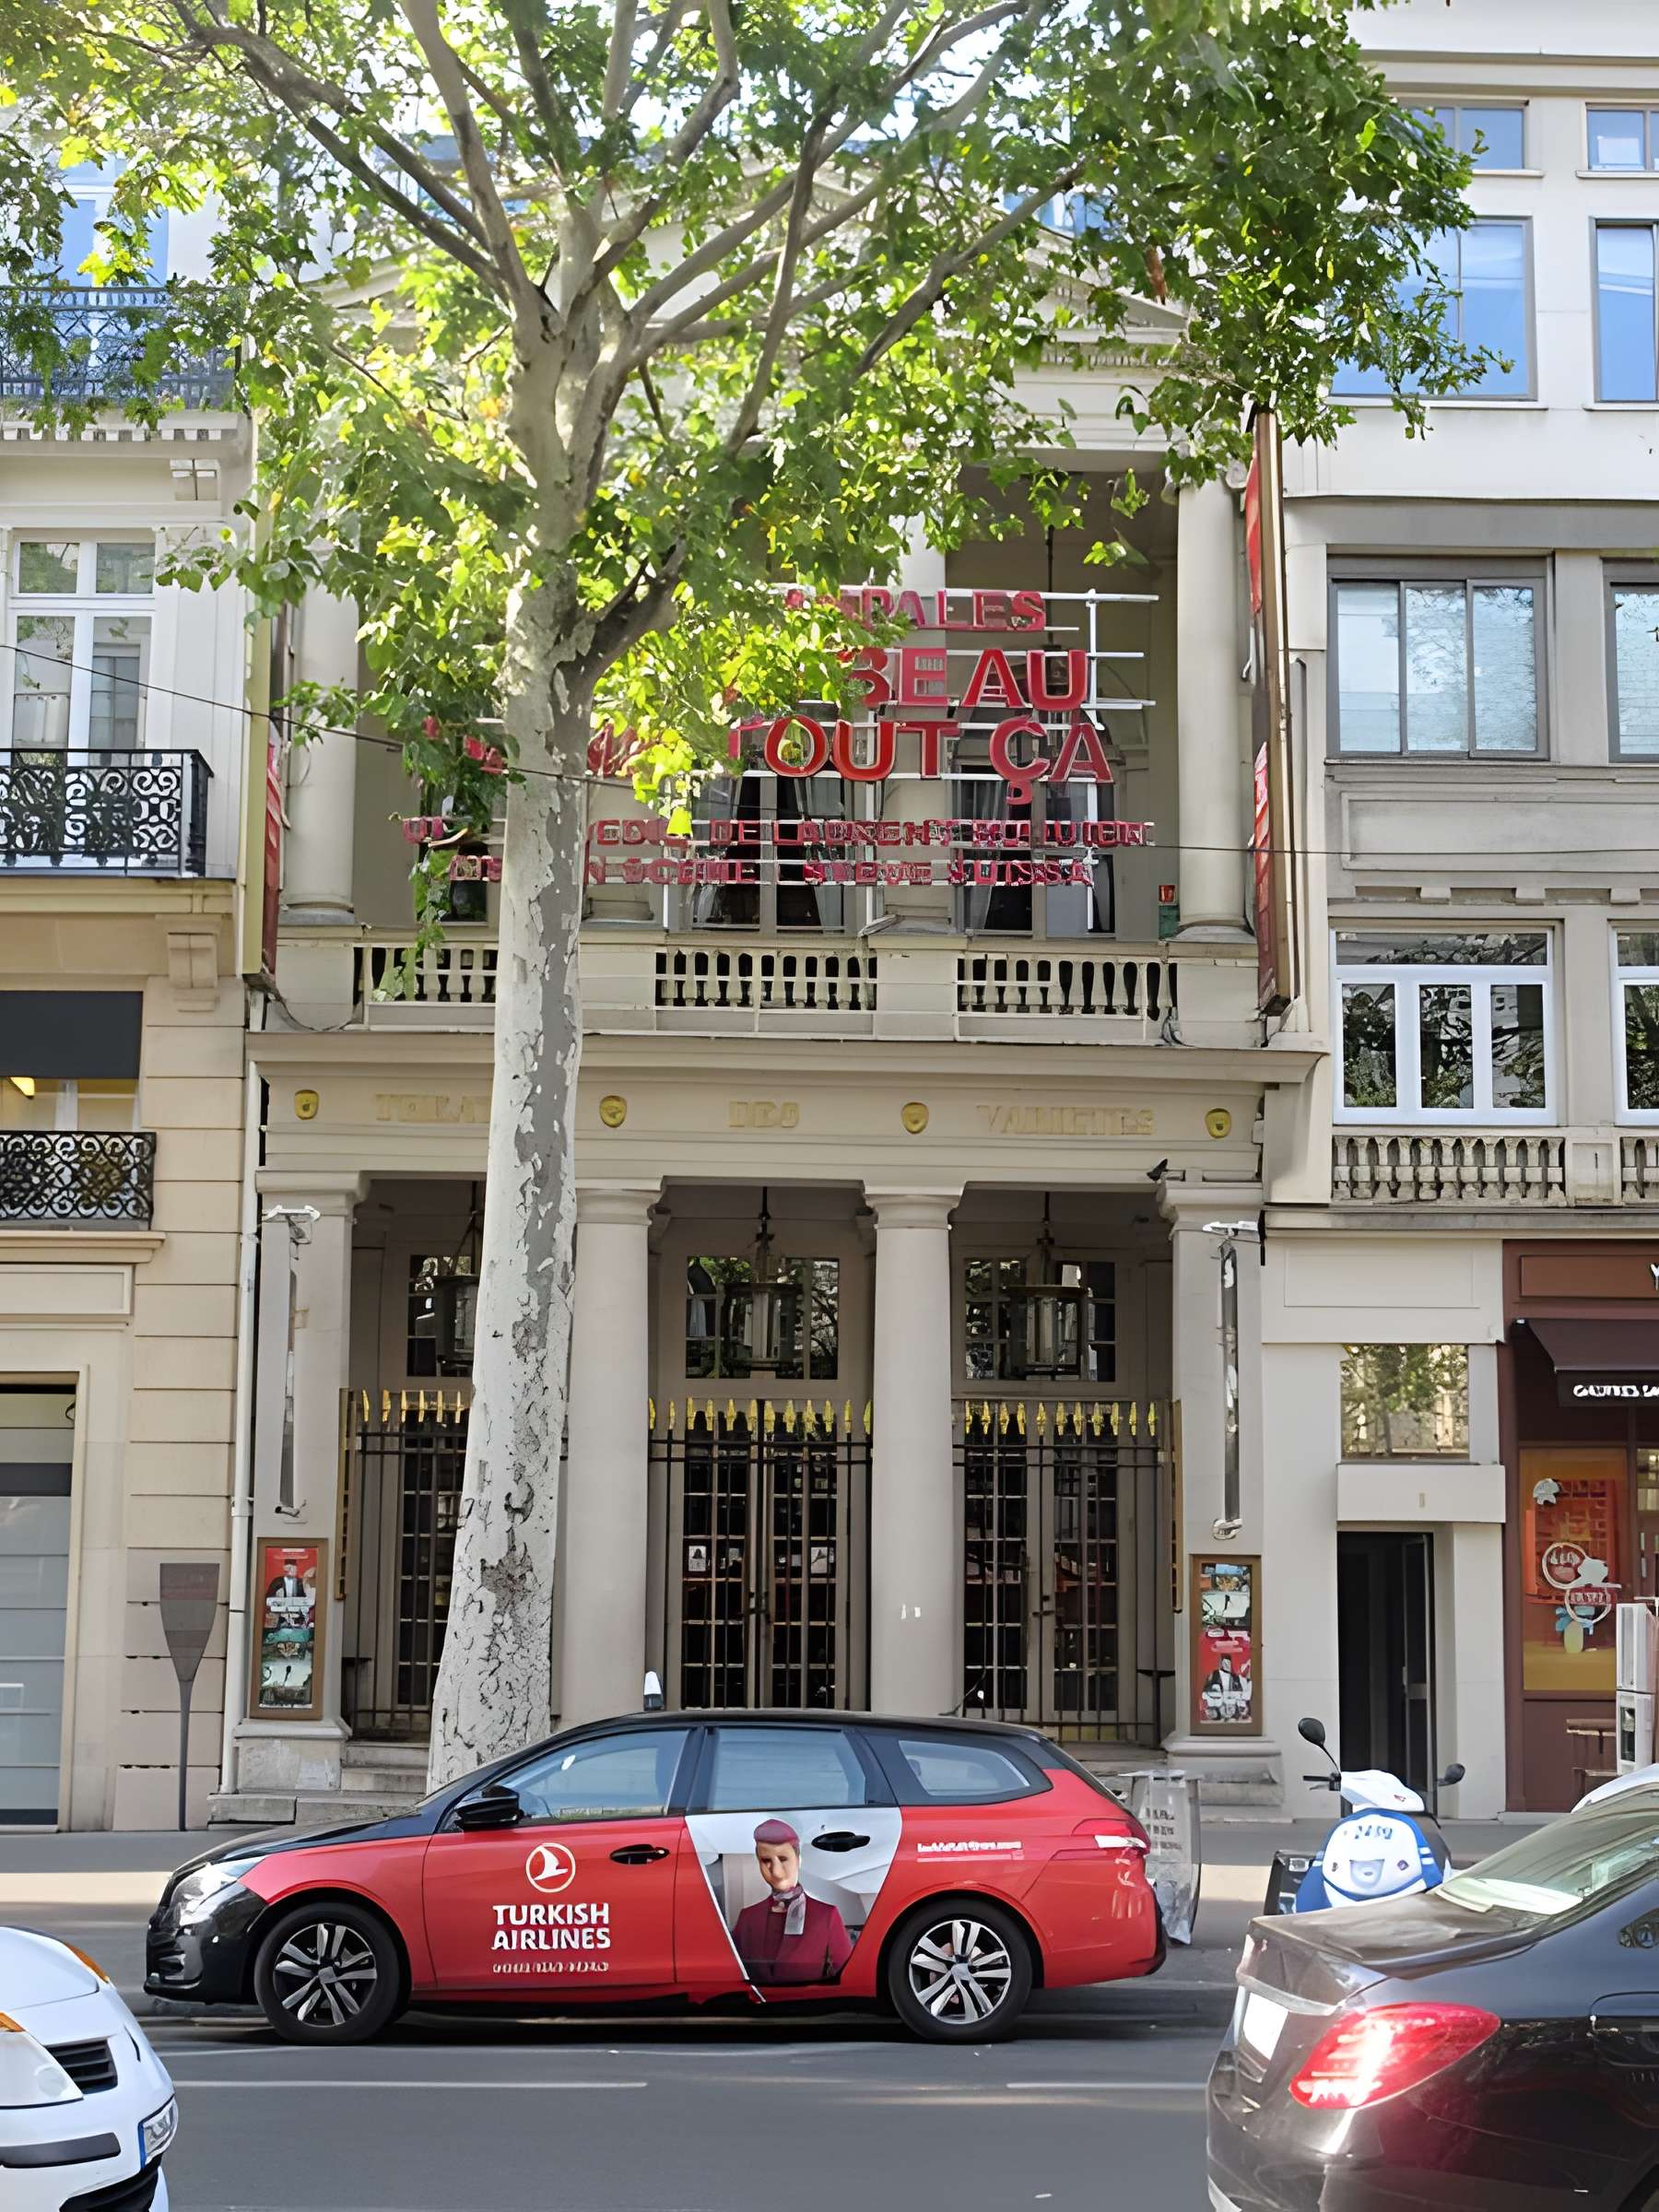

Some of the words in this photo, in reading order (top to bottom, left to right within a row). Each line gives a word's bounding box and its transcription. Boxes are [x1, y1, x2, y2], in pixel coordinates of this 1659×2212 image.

[848, 647, 1088, 711] BEAU
[989, 714, 1114, 806] ÇA
[492, 1902, 609, 1925] TURKISH
[490, 1927, 611, 1950] AIRLINES
